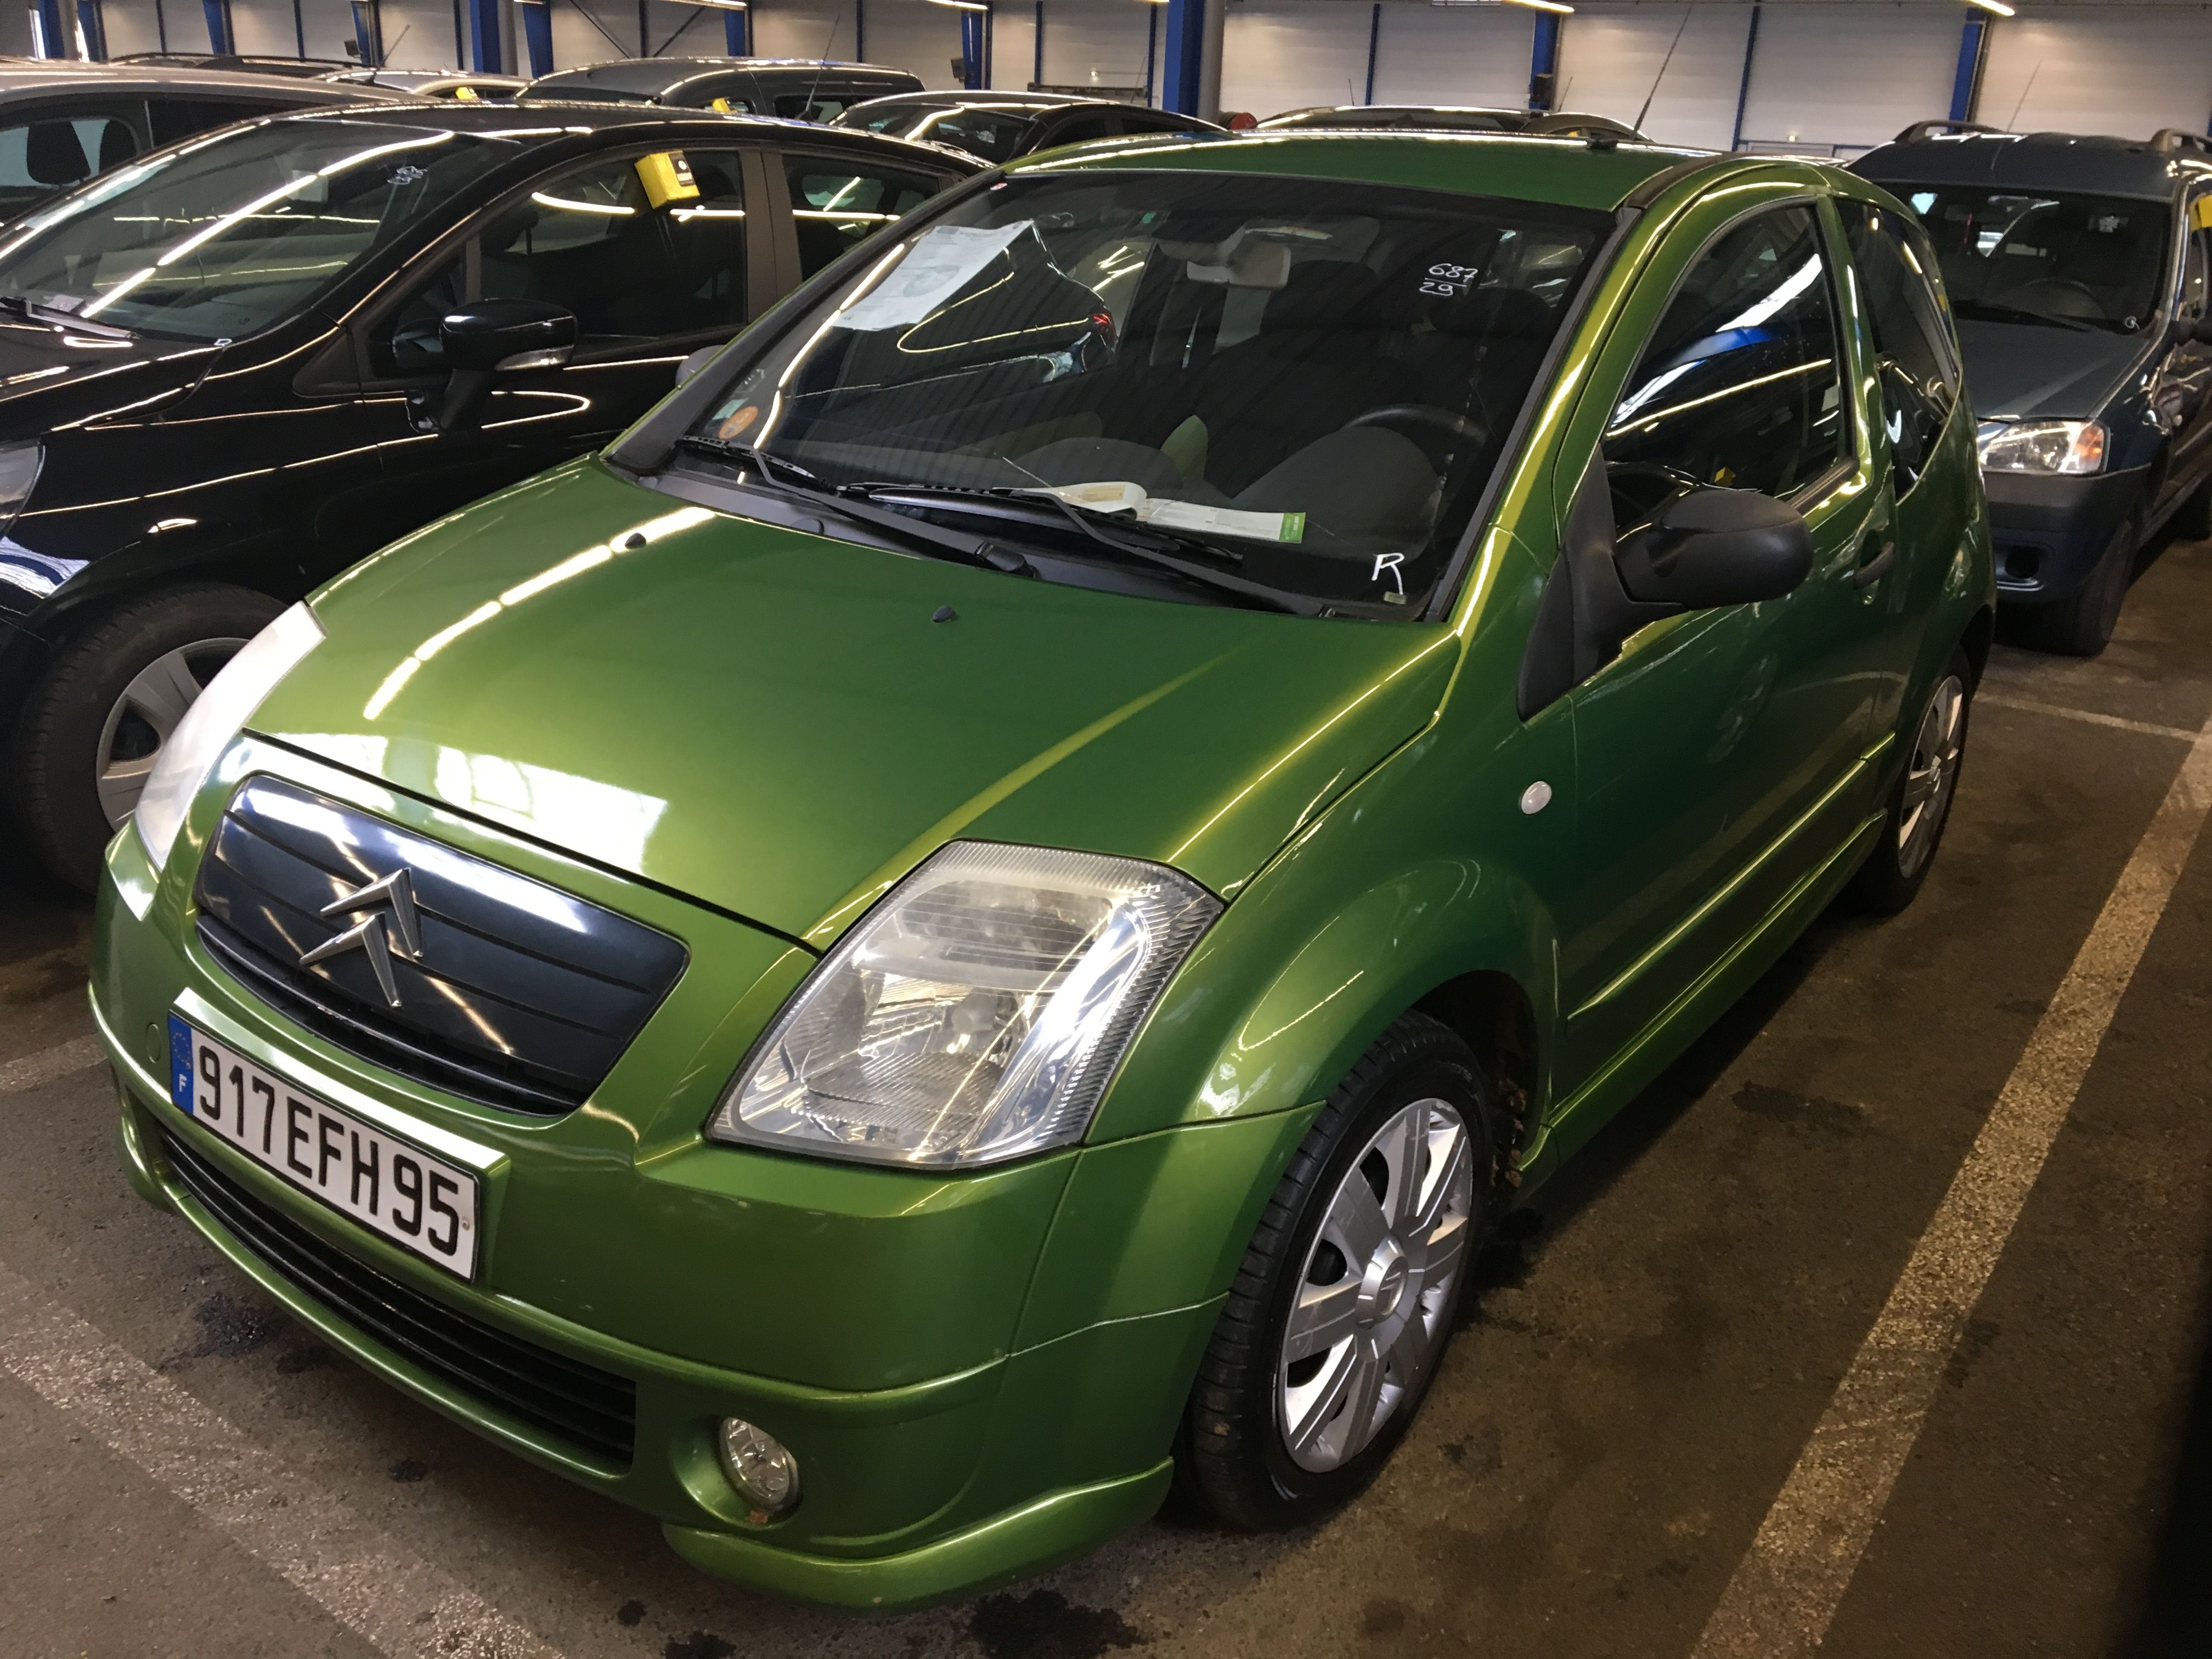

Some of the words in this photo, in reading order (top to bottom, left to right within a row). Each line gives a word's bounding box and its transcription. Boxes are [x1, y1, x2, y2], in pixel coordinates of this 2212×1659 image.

[1429, 263, 1479, 283] 687
[1372, 552, 1405, 595] R
[178, 1073, 187, 1092] F
